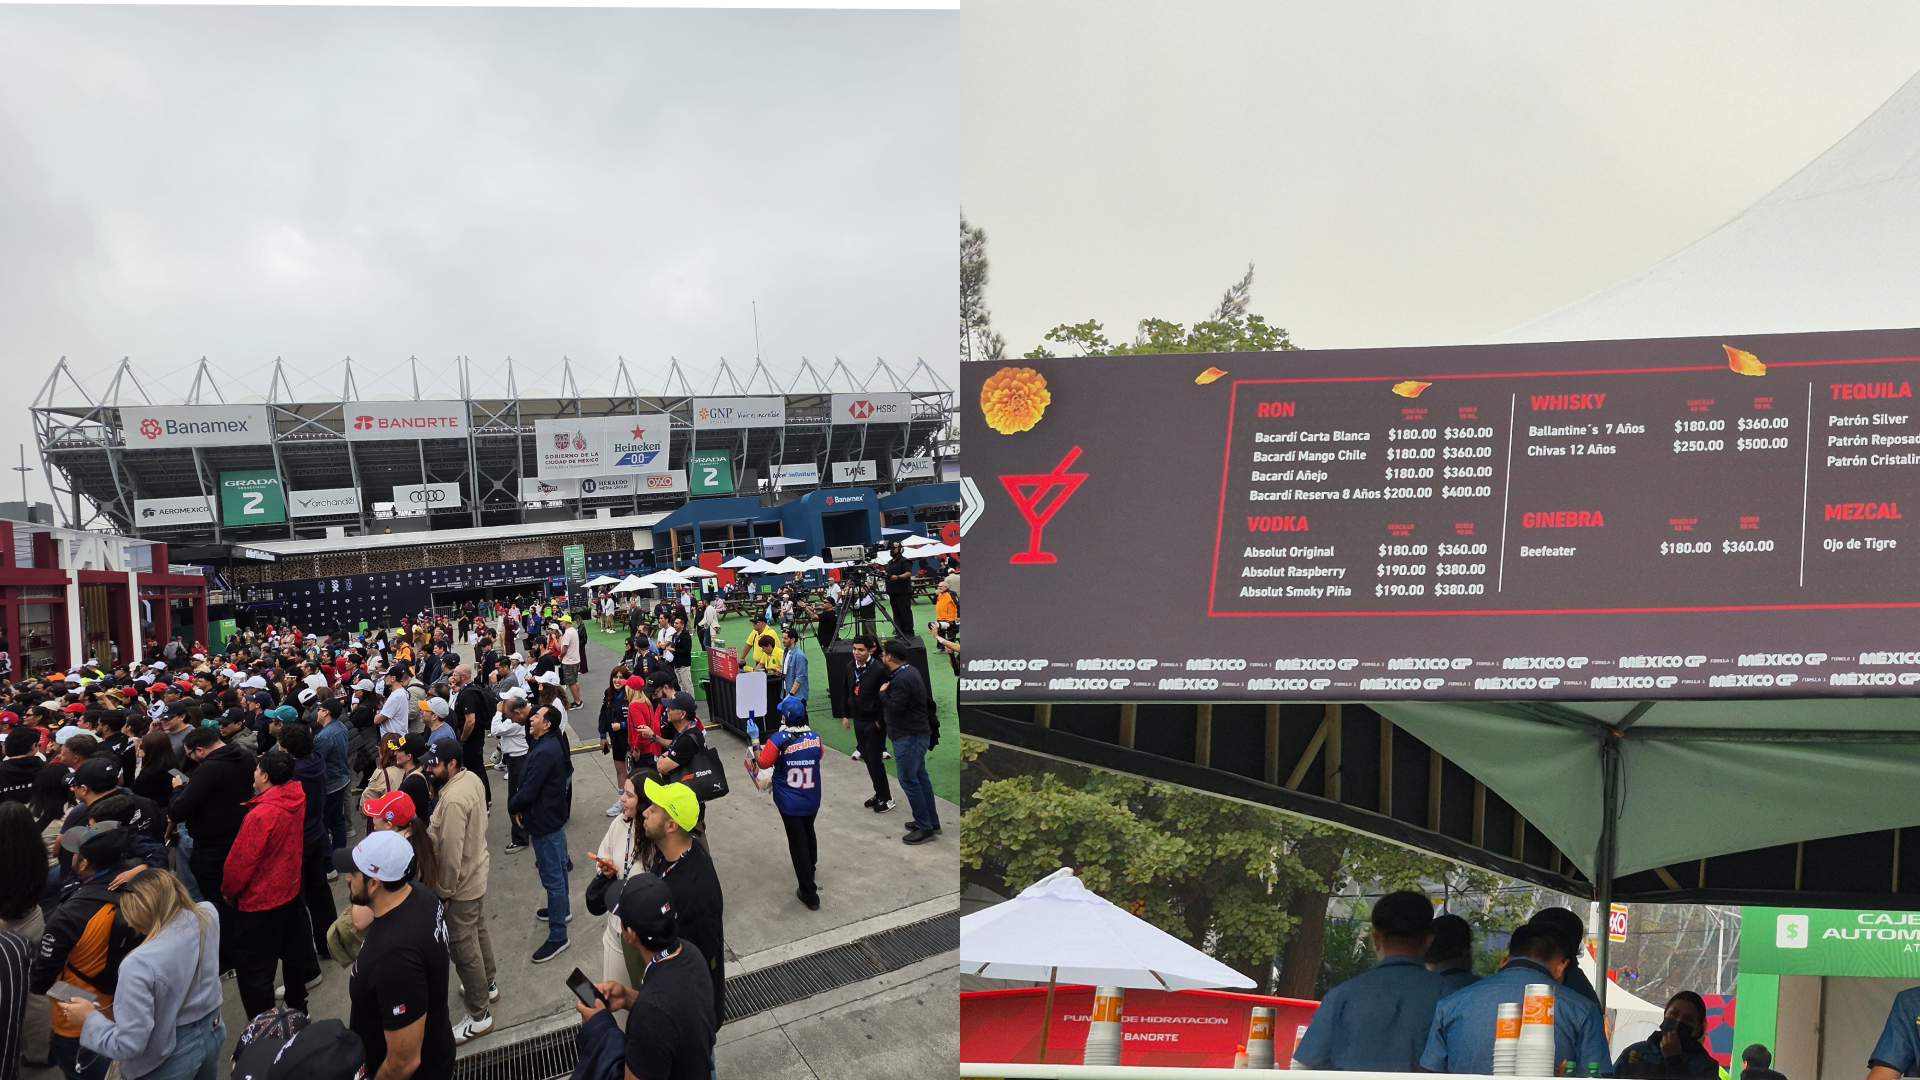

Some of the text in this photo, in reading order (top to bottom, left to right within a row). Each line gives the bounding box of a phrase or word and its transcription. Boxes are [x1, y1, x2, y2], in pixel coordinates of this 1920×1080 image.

[1830, 381, 1912, 400] TEQUILA
[876, 404, 896, 413] HSBC
[1257, 402, 1295, 417] RON
[1530, 394, 1606, 410] WHISKY
[710, 408, 733, 418] GNP
[1829, 414, 1908, 426] Patrón Silver
[166, 419, 248, 435] Banamex
[378, 416, 458, 429] BANORTE
[1605, 424, 1613, 434] 7
[1616, 424, 1645, 434] Años
[1674, 420, 1725, 434] $180.00
[1738, 418, 1788, 431] $360.00
[1255, 427, 1493, 443] Bacardí Carta Blanca $180.00 $360.00
[1828, 435, 1868, 446] Patrón
[614, 442, 661, 452] Heineken
[1254, 446, 1492, 463] Bacardí Mango Chile $180.00 $360.00
[1528, 438, 1788, 457] Chivas 12 Años $250.00 $500.00
[1827, 455, 1867, 467] Patrón
[225, 478, 278, 486] GRADA
[648, 476, 672, 487] OXXO
[703, 468, 718, 486] 2
[1252, 466, 1492, 483] Bacardí Añejo $180.00 $360.00
[1250, 486, 1491, 501] Bacardí Reserva 8 Años $200.00 $400.00
[159, 506, 209, 515] AEROMEXICO
[242, 492, 265, 514] 2
[1522, 511, 1604, 528] GINEBRA
[1824, 503, 1901, 520] MEZCAL
[1247, 516, 1308, 532] VODKA
[50, 531, 131, 572] TANE
[1244, 543, 1487, 559] Absolut Original $180.00 $360.00
[1521, 540, 1774, 557] Beefeater $180.00 $360.00
[1824, 538, 1897, 552] Ojo de Tigre
[1242, 563, 1486, 579] Absolut Raspberry $190.00 $380.00
[1240, 583, 1484, 599] Absolut Smoky Piña $190.00 $380.00
[968, 659, 1027, 671] MÉXICO
[1028, 659, 1048, 670] GP
[1076, 658, 1135, 670] MÉXICO
[1137, 659, 1158, 670] GP
[1186, 658, 1246, 670] MÉXICO
[1275, 658, 1336, 670] MÉXICO
[1338, 659, 1359, 670] GP
[1388, 657, 1449, 670] MÉXICO
[1451, 658, 1472, 669] GP
[1503, 656, 1565, 669] MÉXICO
[1567, 657, 1588, 668] GP
[1619, 655, 1683, 668] MÉXICO
[1685, 655, 1706, 667] GP
[1738, 653, 1803, 666] MÉXICO
[1805, 653, 1827, 665] GP
[786, 767, 815, 789] 01
[1858, 914, 1920, 925] CAJE
[1140, 1016, 1228, 1024] HIDRATACIÓN
[1124, 1033, 1179, 1042] BANORTE
